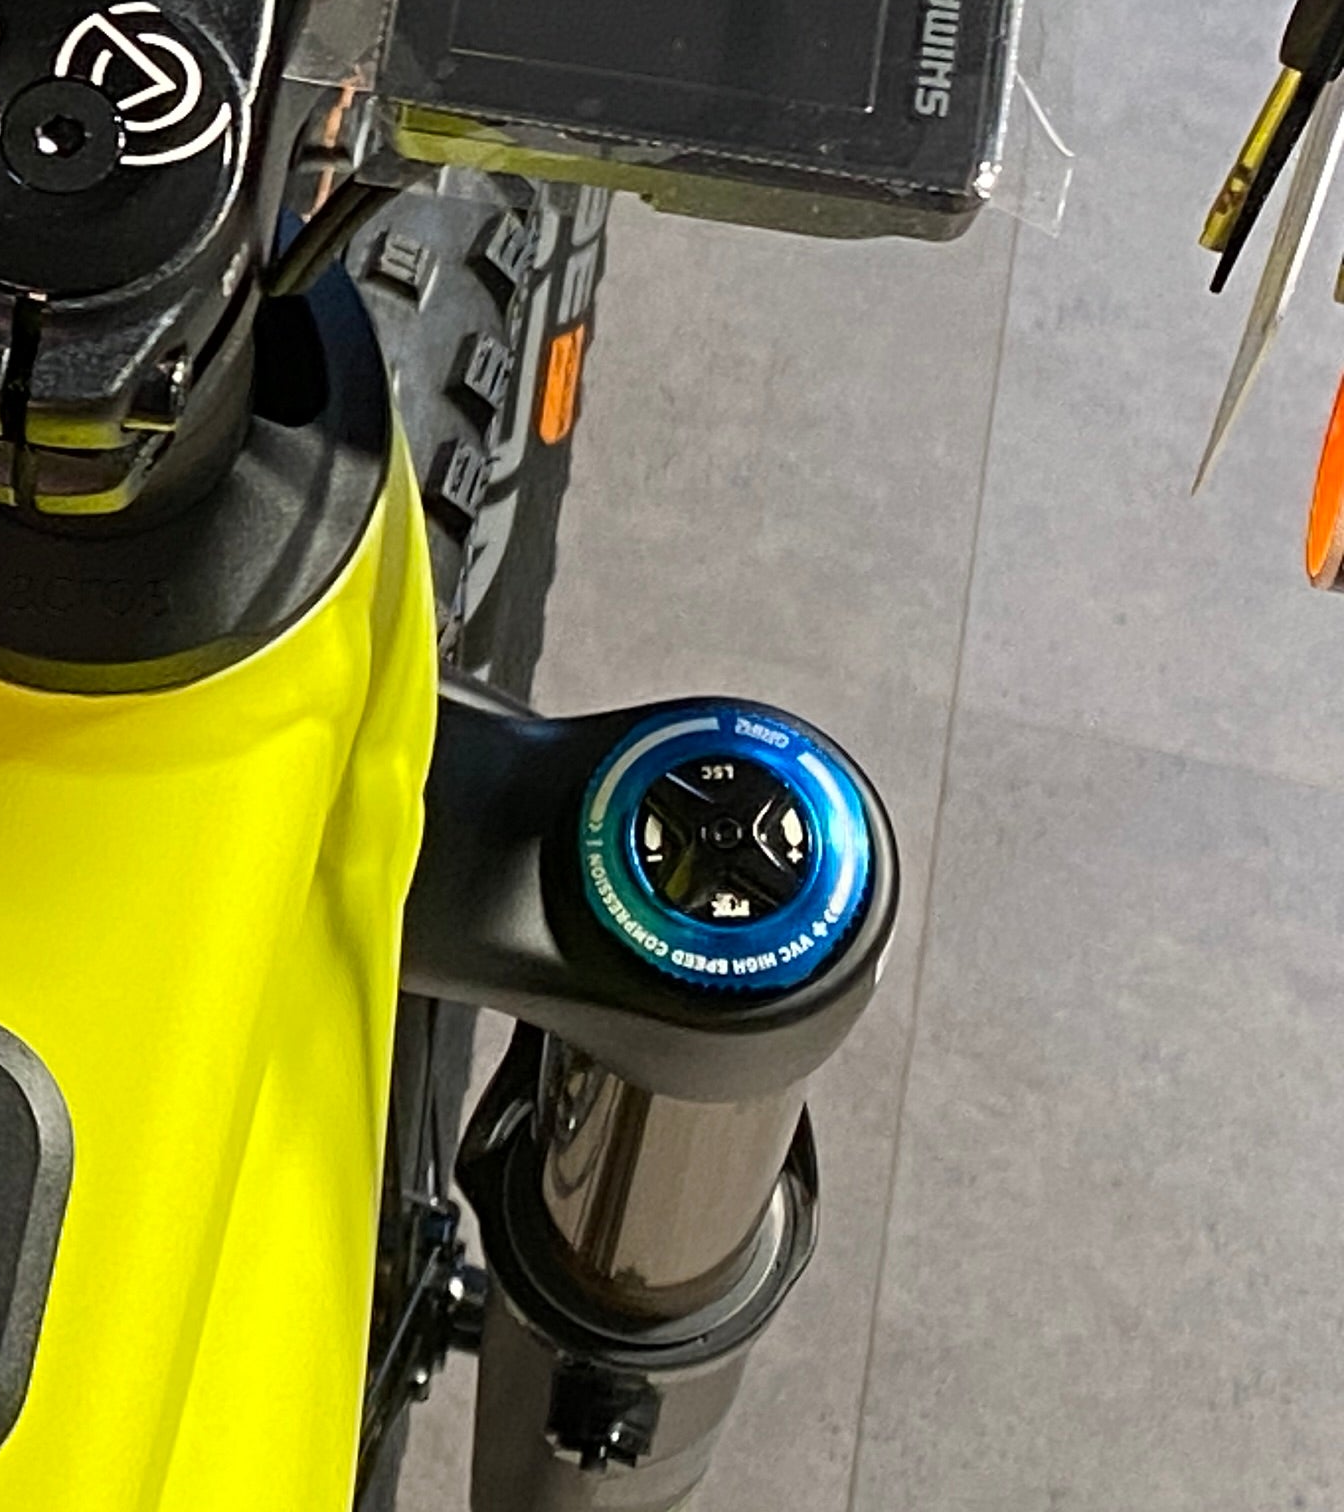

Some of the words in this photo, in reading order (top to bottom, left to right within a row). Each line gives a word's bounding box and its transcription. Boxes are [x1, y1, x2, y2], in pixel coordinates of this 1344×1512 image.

[586, 852, 670, 958] COMPRESSION
[778, 934, 815, 963] VVC
[670, 950, 730, 976] SPEED
[732, 952, 778, 976] HIGH
